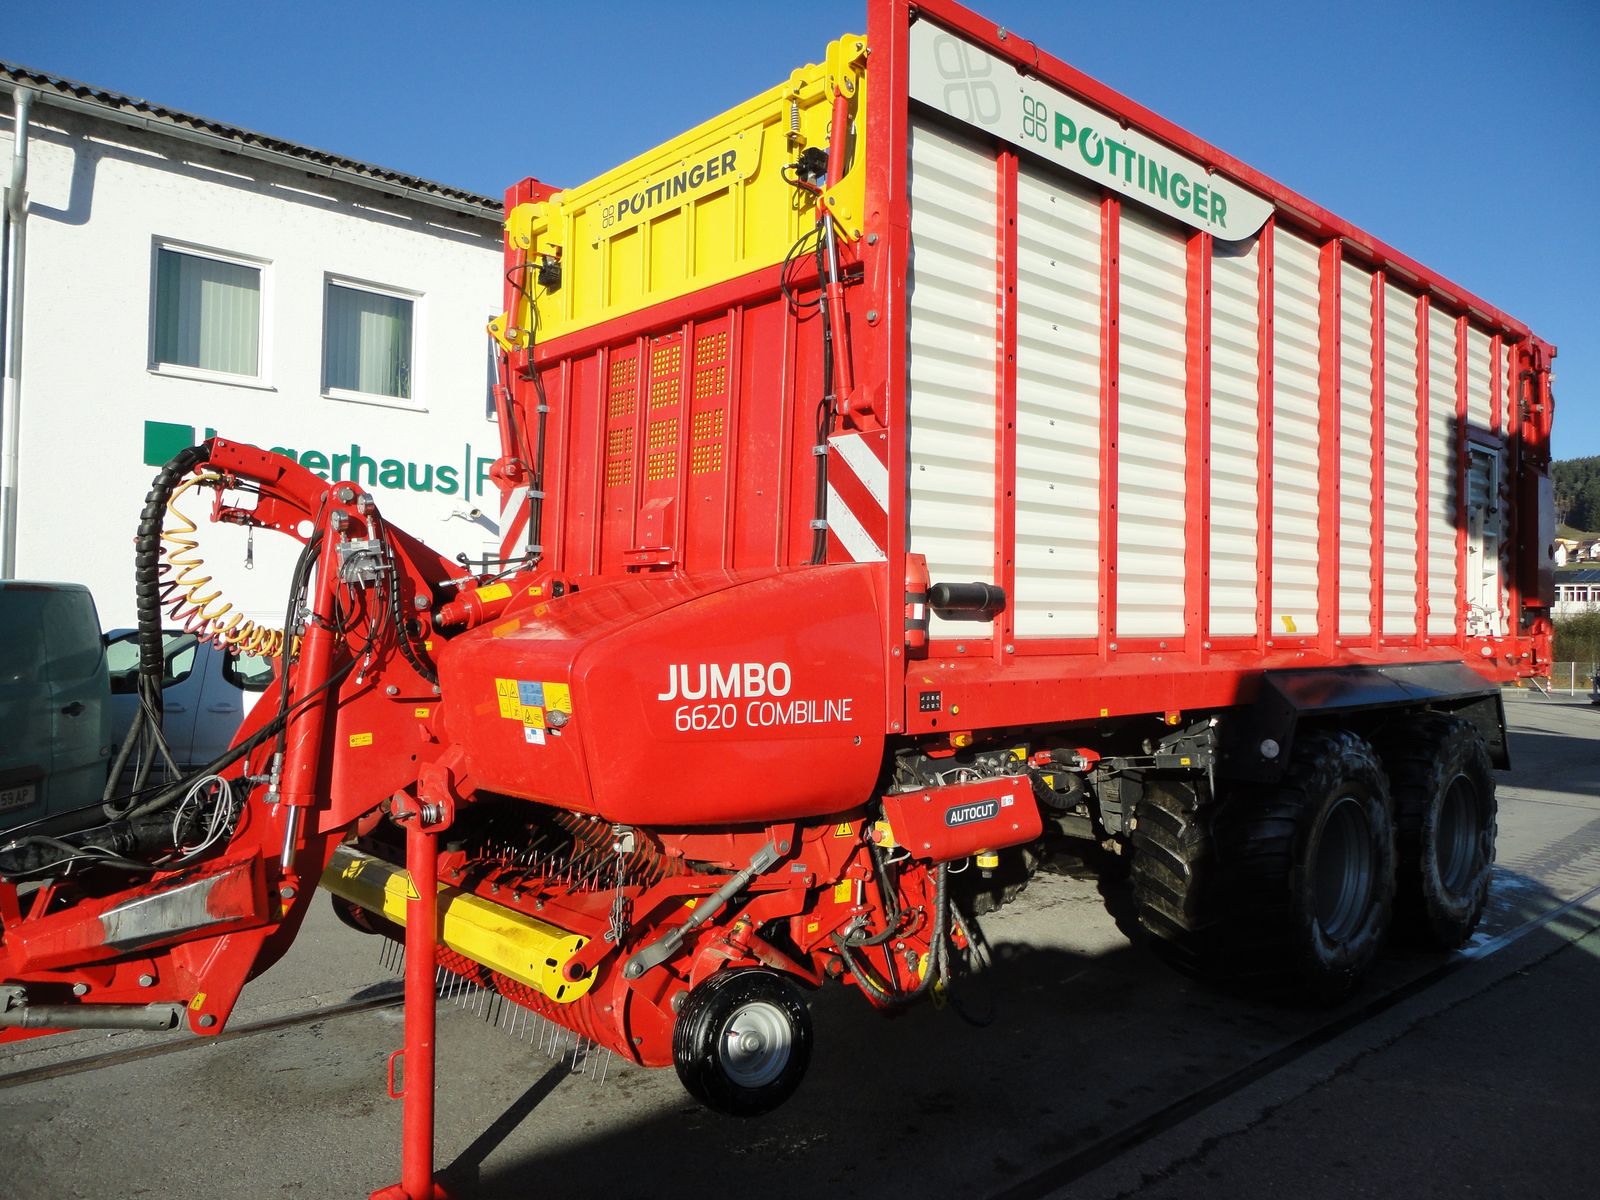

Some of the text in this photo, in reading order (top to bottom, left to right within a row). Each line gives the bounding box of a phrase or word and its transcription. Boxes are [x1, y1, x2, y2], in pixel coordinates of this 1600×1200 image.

[617, 149, 737, 222] PÖTTINGER
[1054, 111, 1228, 229] PÖTTINGER
[205, 427, 460, 496] erhaus
[658, 662, 792, 701] JUMBO
[675, 698, 853, 731] 6620 COMBILINE
[950, 803, 995, 824] AUTOCUT
